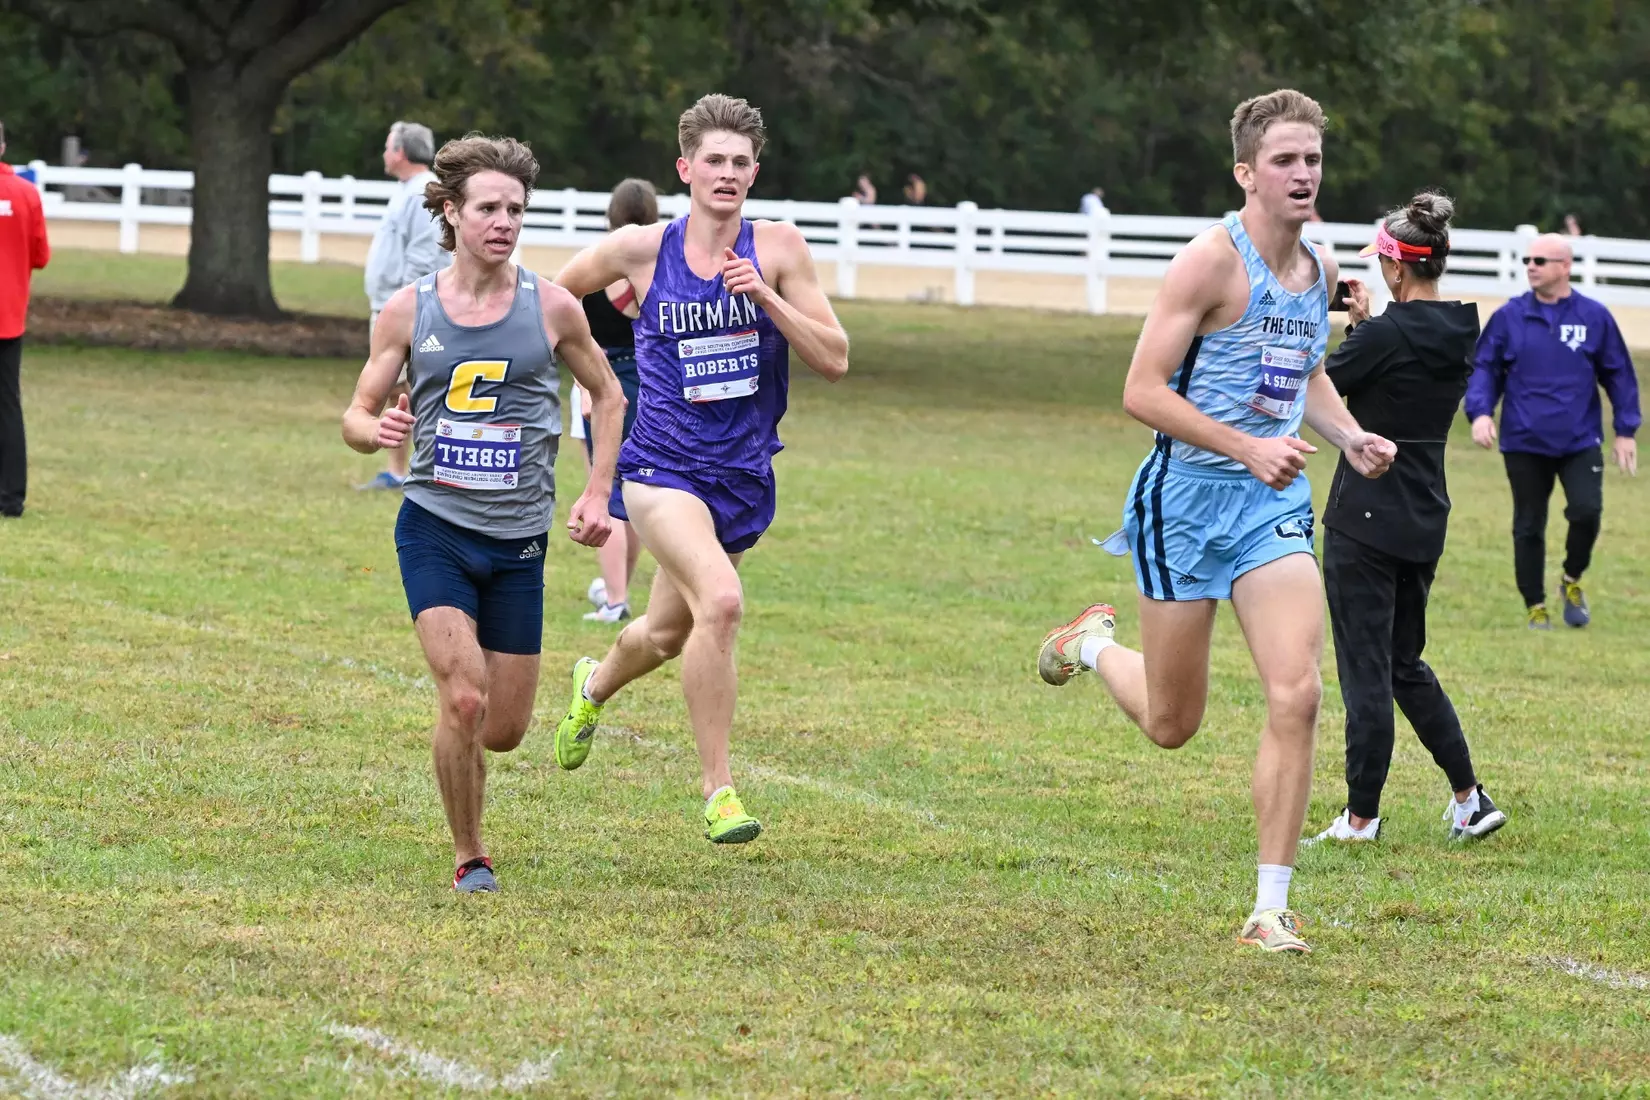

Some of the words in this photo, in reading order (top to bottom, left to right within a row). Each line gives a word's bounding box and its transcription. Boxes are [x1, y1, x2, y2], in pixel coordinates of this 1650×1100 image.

[658, 293, 758, 334] FURMAN
[1263, 316, 1285, 335] THE
[1559, 324, 1587, 343] FU
[419, 344, 444, 353] adidas
[684, 353, 758, 378] ROBERTS
[444, 358, 513, 415] C
[1264, 372, 1272, 386] S.
[438, 443, 517, 468] ISBELL
